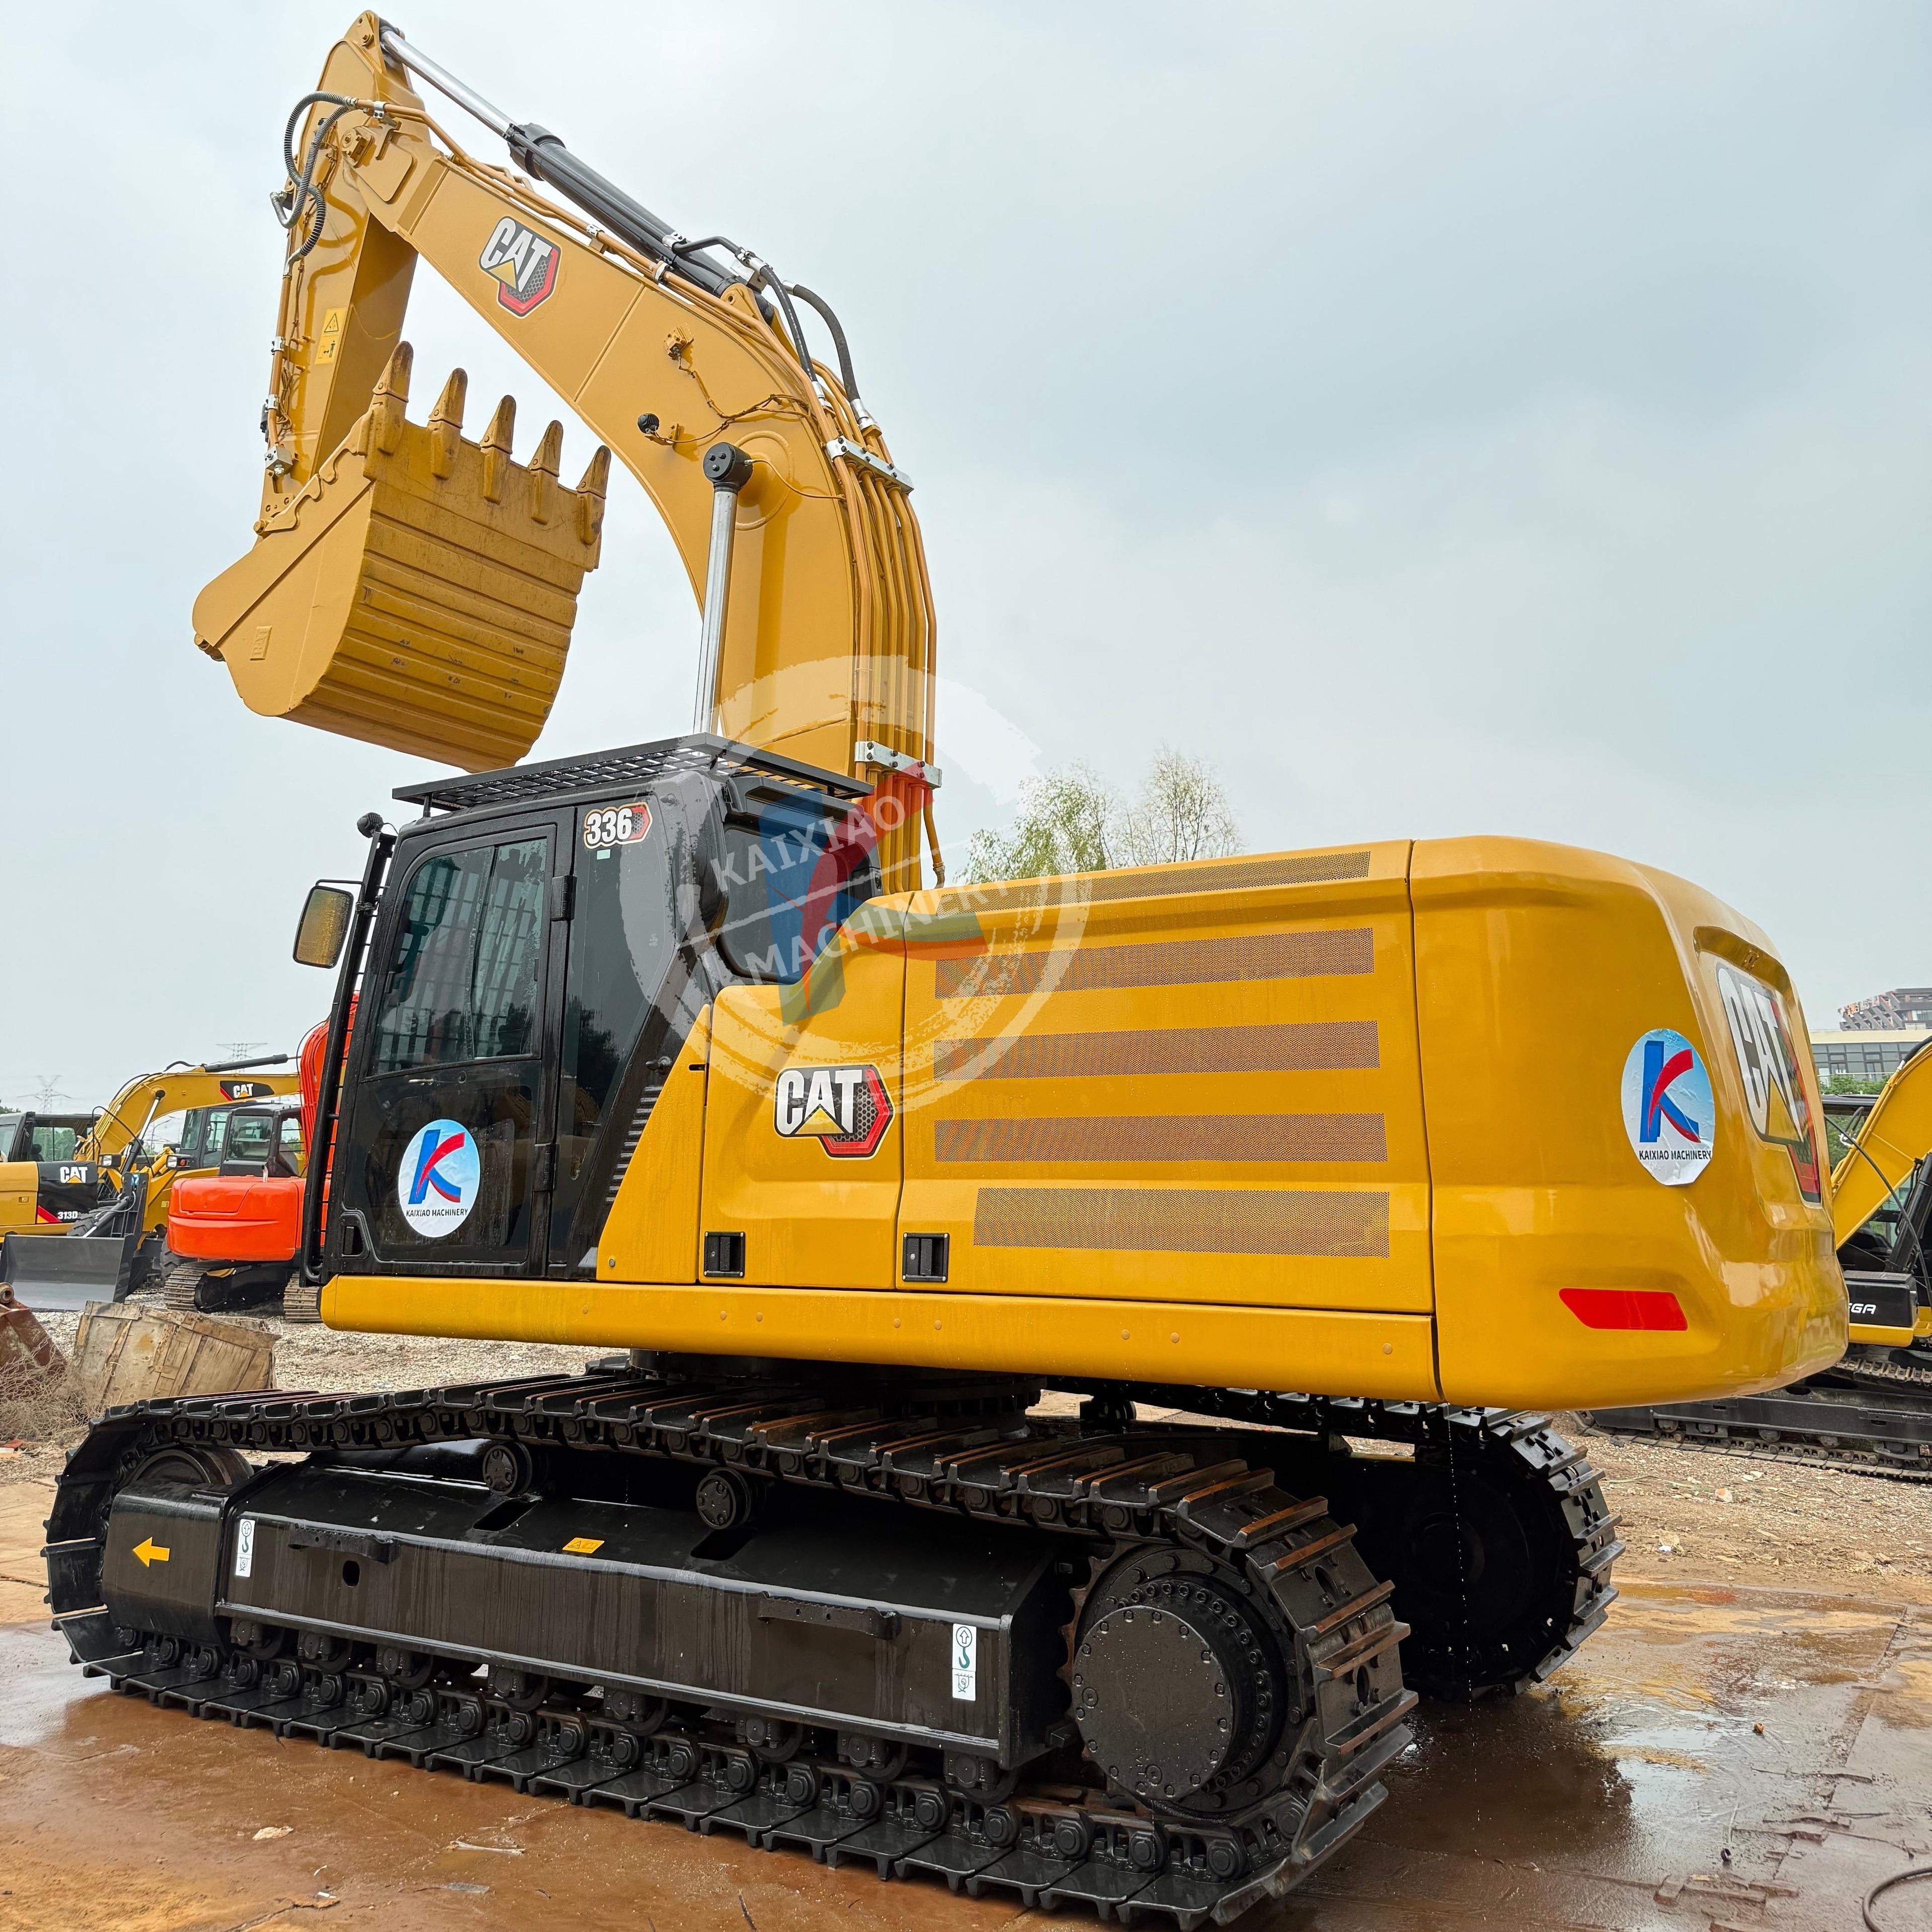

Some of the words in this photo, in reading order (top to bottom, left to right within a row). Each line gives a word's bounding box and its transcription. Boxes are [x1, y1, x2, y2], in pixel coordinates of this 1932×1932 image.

[481, 217, 552, 293] CAT
[587, 808, 632, 844] 336
[1718, 968, 1804, 1143] CAT
[233, 1083, 254, 1098] CAT
[776, 1069, 862, 1135] CAT
[1639, 1150, 1669, 1160] KAIXIAO
[1671, 1150, 1712, 1160] MACHINERY
[59, 1166, 88, 1183] CAT
[406, 1209, 430, 1217] KAIXIAO
[432, 1208, 468, 1217] MACHINERY
[1848, 1303, 1876, 1314] GA
